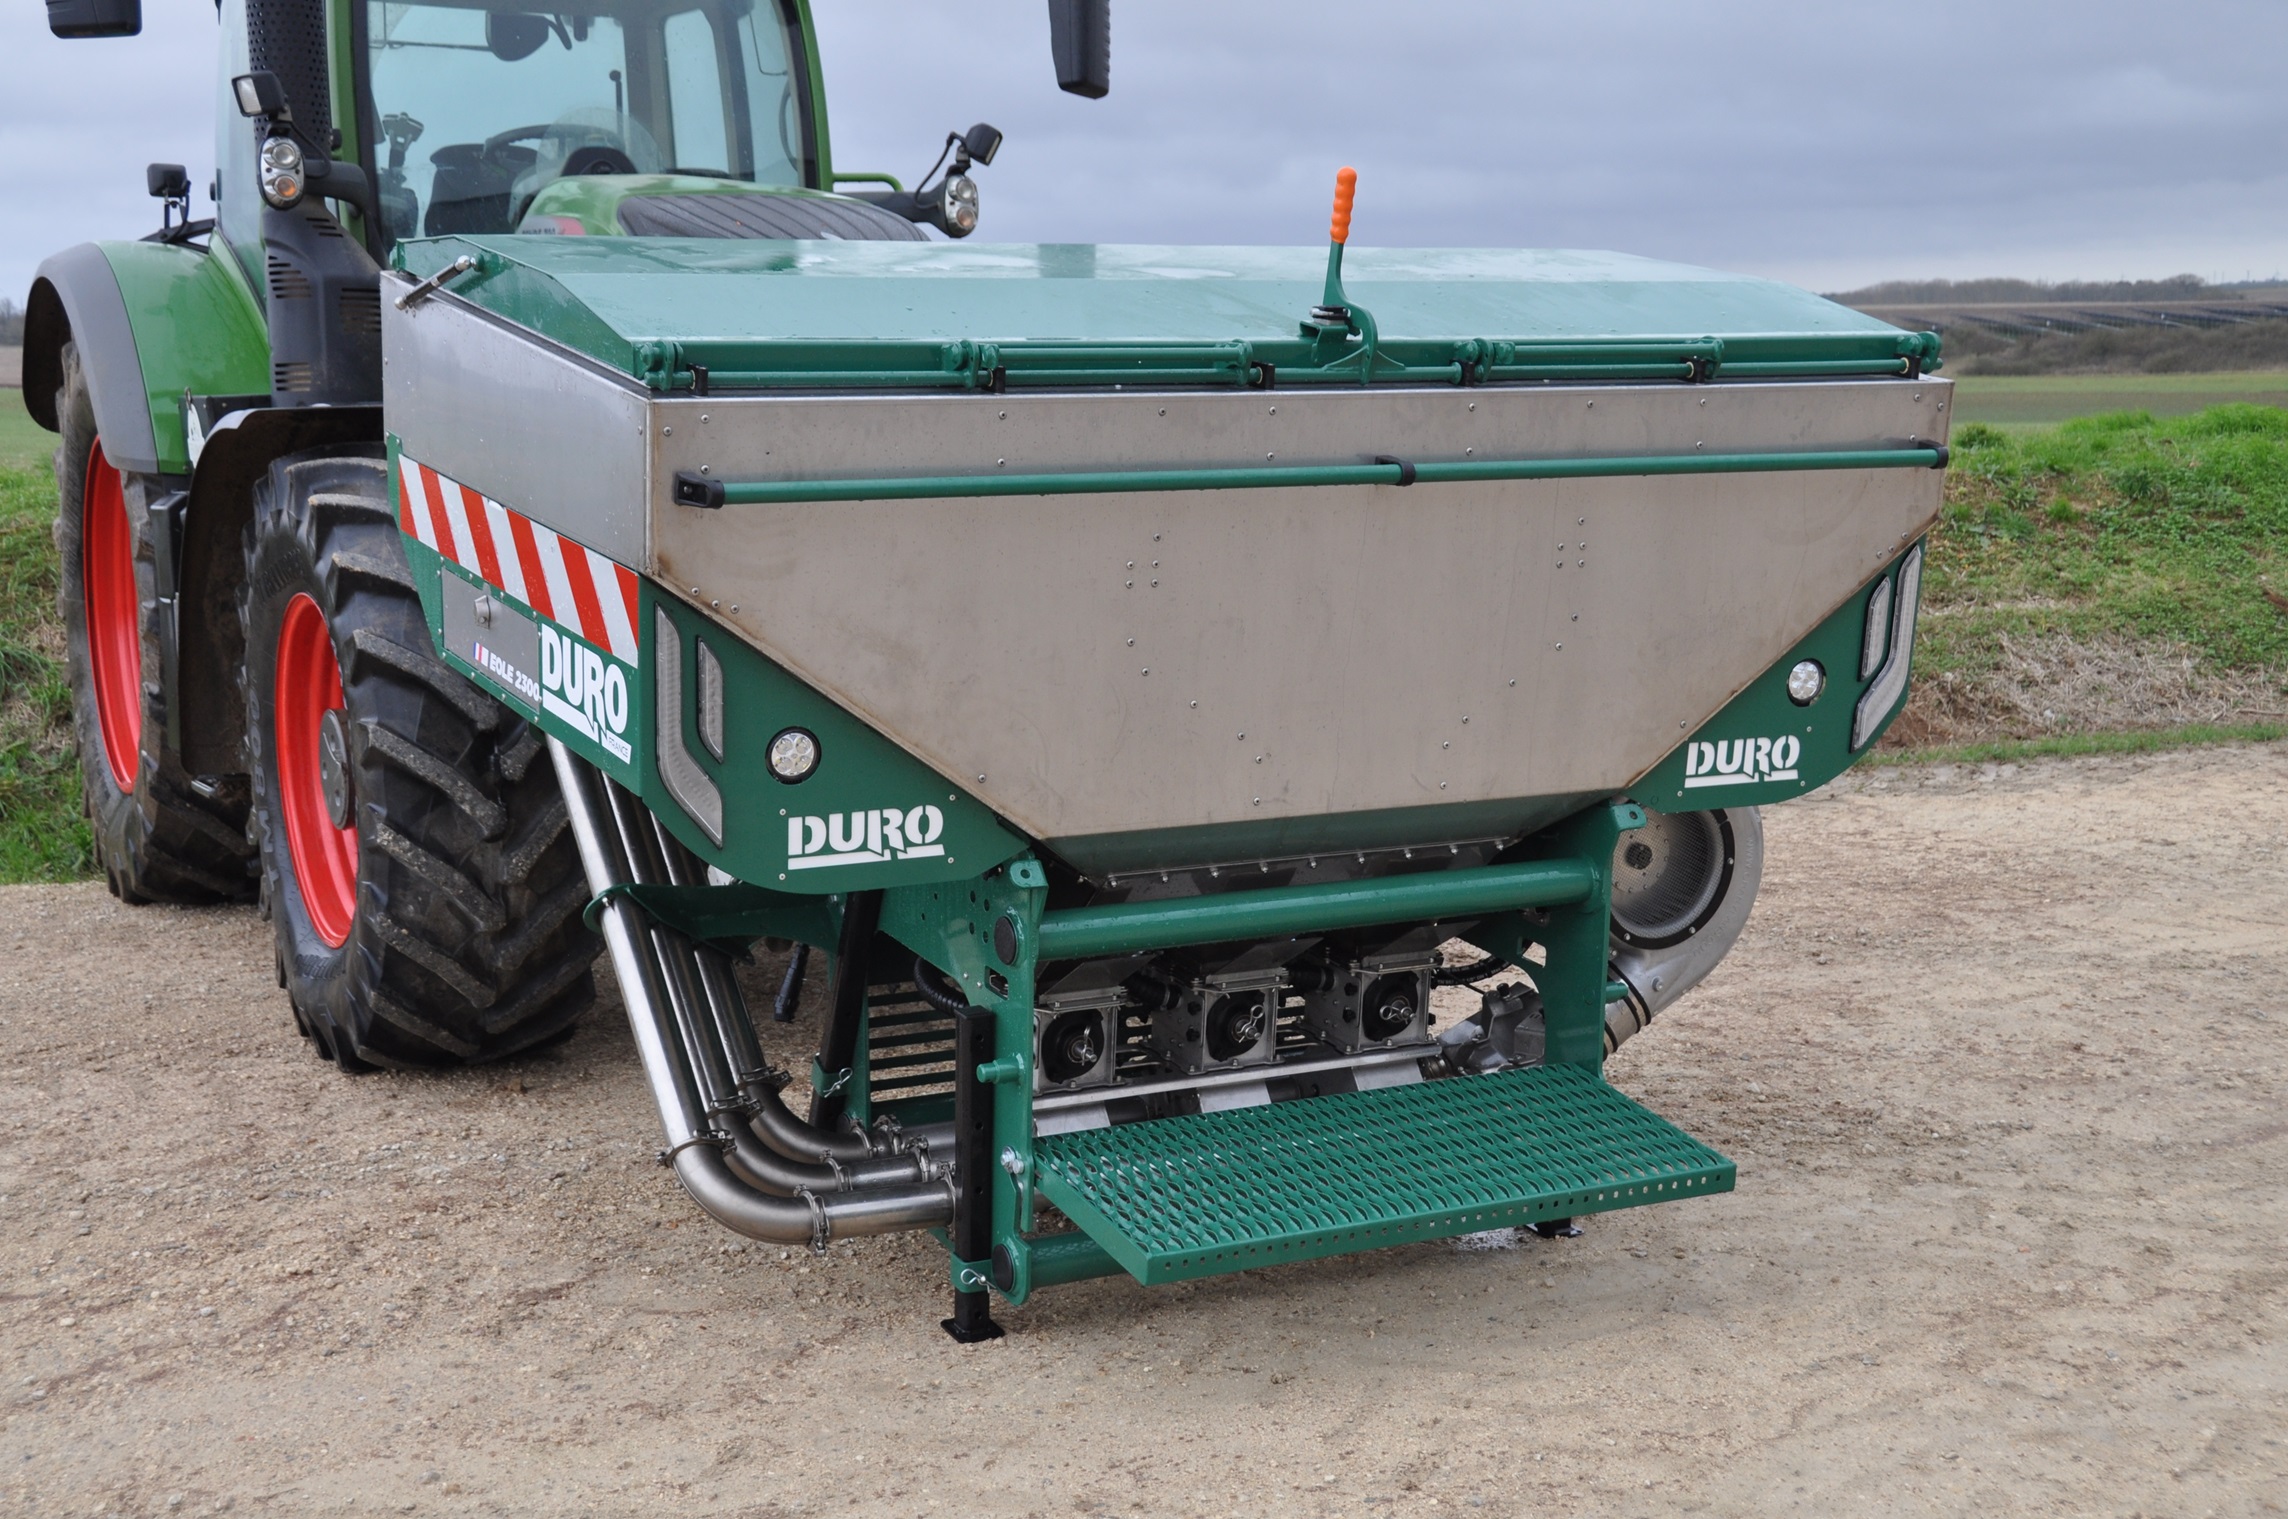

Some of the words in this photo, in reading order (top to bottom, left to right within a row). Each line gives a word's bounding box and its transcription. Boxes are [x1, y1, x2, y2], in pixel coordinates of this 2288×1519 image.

[490, 652, 515, 684] EOLE
[515, 671, 540, 702] 2300
[542, 623, 628, 735] DURO
[1685, 734, 1801, 777] DURO
[788, 804, 944, 855] DURO
